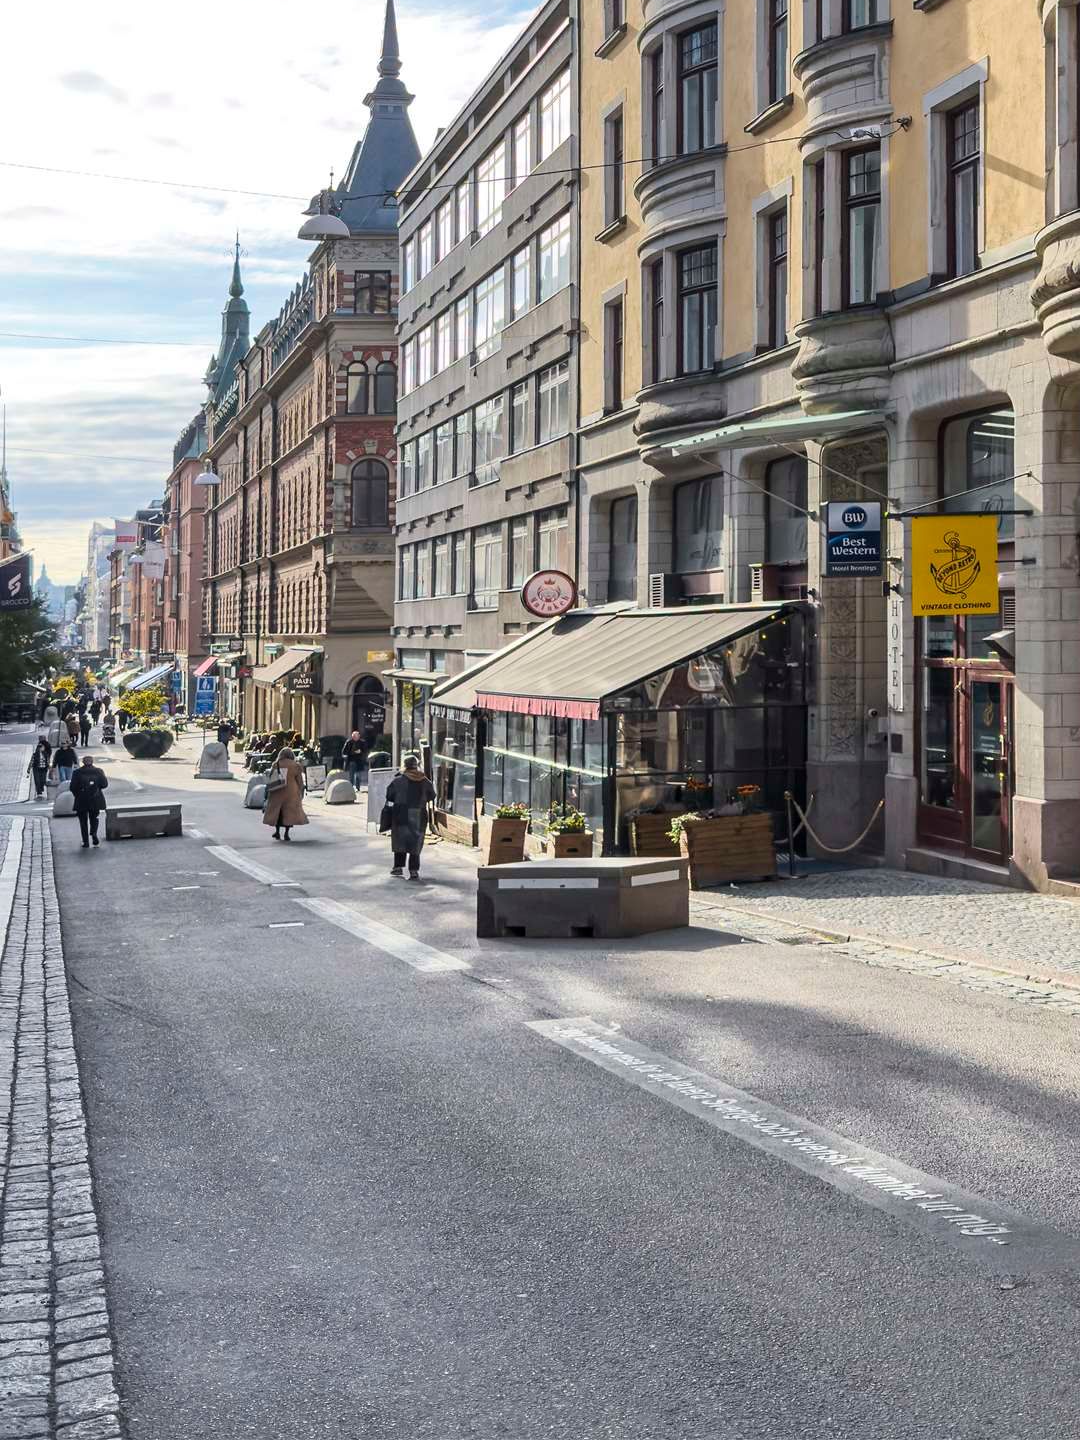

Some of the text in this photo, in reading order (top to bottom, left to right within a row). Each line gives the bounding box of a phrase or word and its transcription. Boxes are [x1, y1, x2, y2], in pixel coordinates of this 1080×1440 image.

[844, 512, 865, 523] BW
[842, 537, 866, 547] Best
[832, 546, 876, 556] Western
[921, 601, 992, 611] VINTAGE CLOTHING
